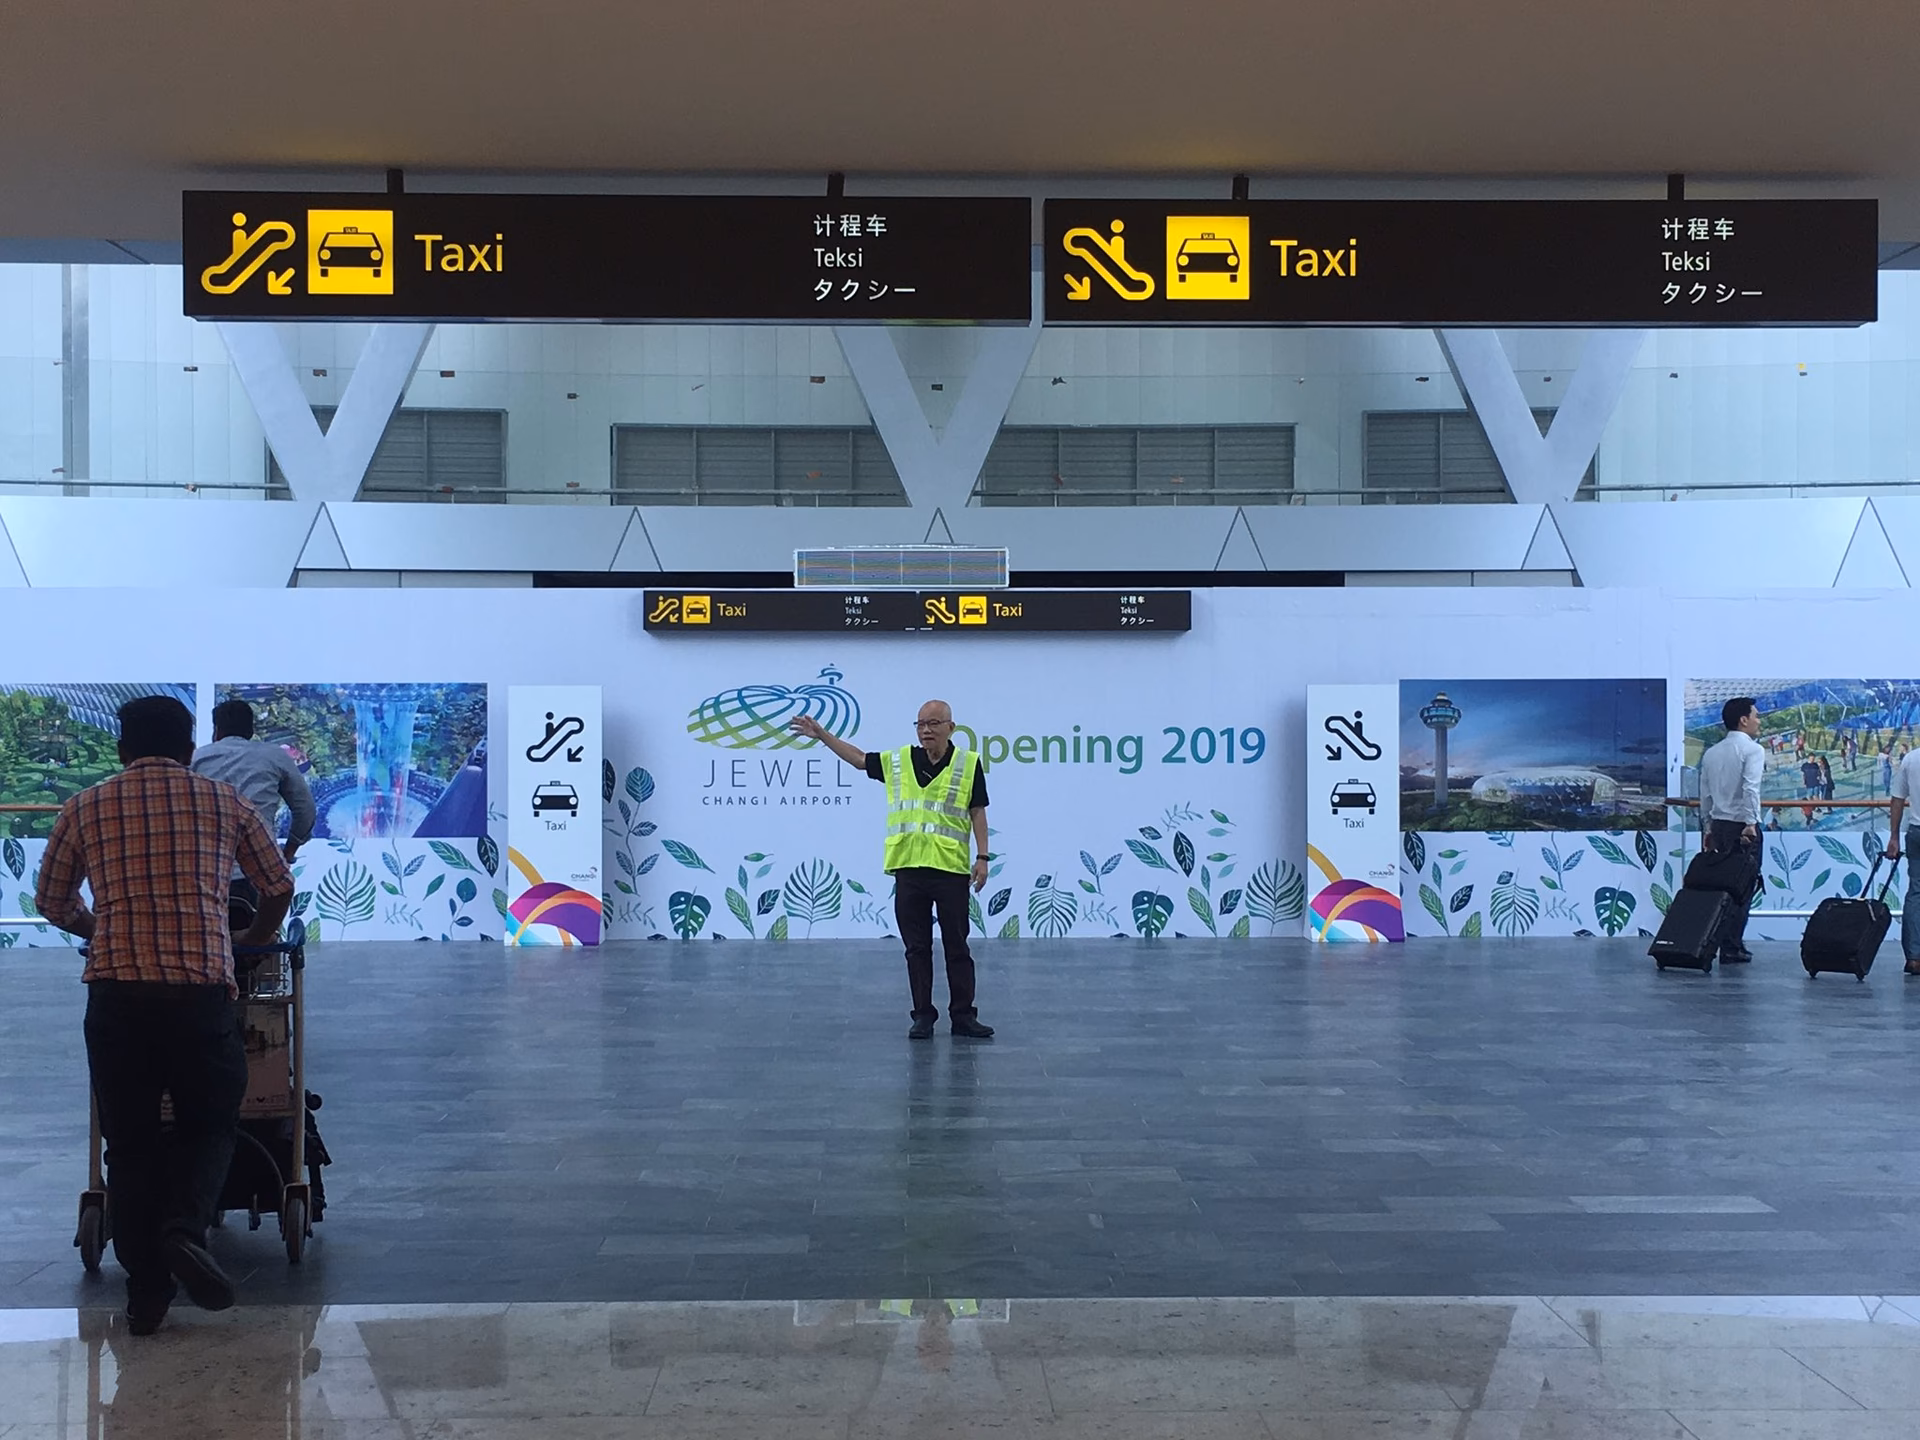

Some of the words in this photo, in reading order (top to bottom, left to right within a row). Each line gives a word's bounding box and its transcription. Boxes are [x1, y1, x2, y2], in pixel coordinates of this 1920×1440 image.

[813, 214, 887, 237] 计程车
[1661, 218, 1735, 241] 计程车
[414, 233, 503, 272] Taxi
[813, 247, 864, 268] Teksi
[1269, 239, 1357, 277] Taxi
[1661, 251, 1711, 271] Teksi
[814, 279, 916, 301] タクシー
[1661, 282, 1763, 304] タクシー
[717, 602, 747, 617] Taxi
[993, 602, 1023, 617] Taxi
[1161, 726, 1266, 765] 2019
[703, 759, 852, 788] JEWEL
[702, 796, 768, 806] CHANGI
[779, 796, 852, 806] AIRPORT
[545, 820, 567, 831] Taxi
[1343, 818, 1365, 828] Taxi
